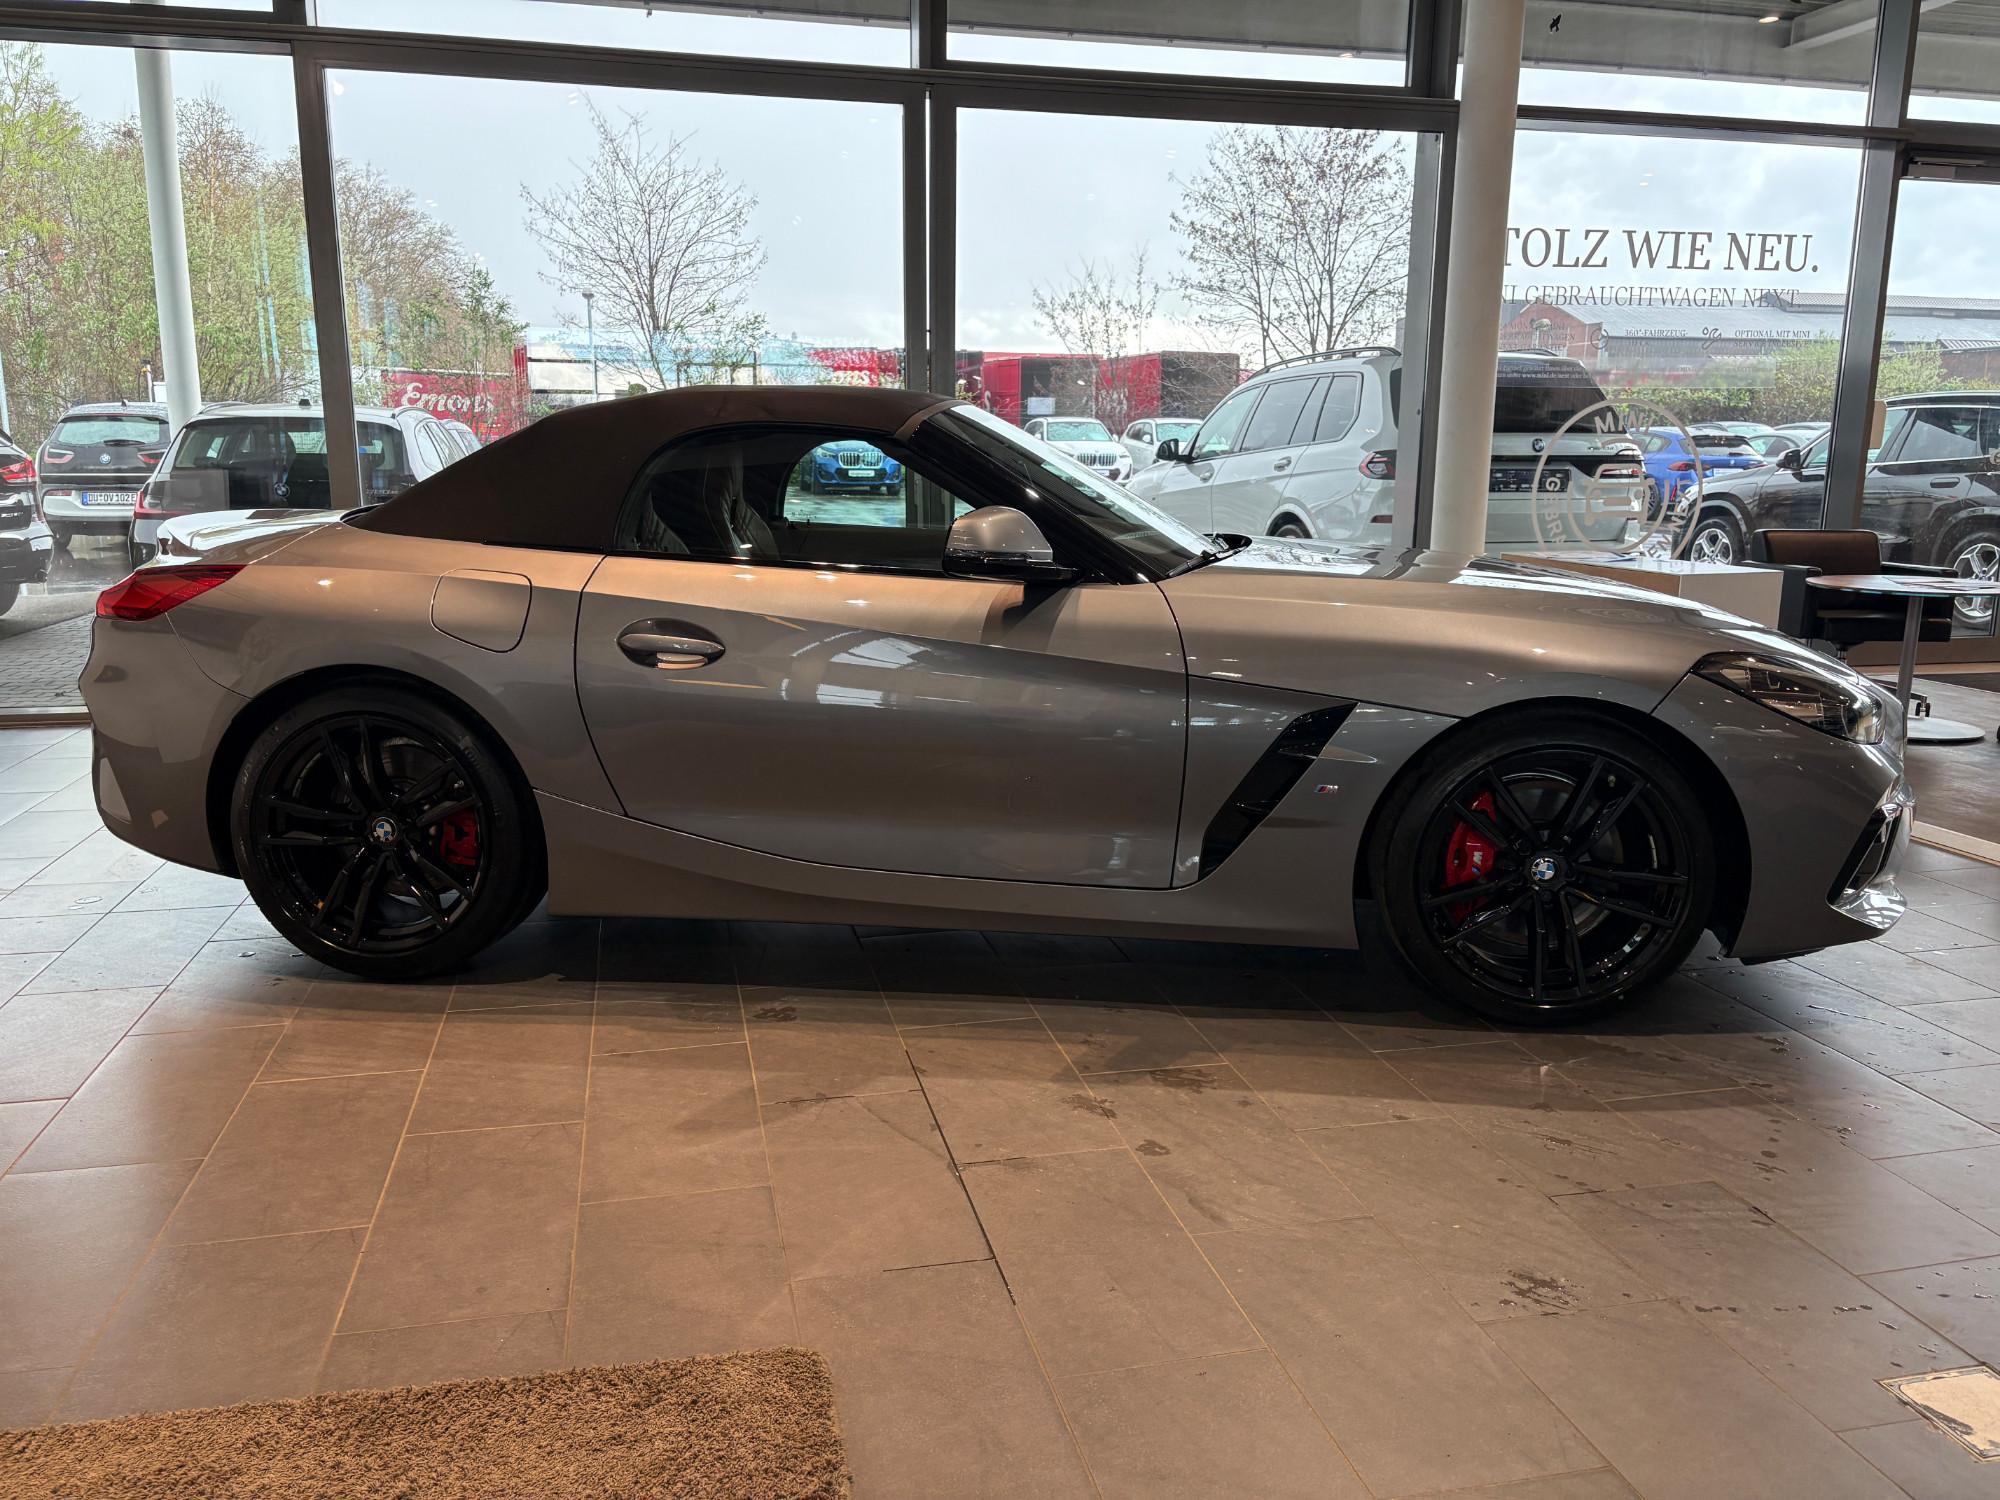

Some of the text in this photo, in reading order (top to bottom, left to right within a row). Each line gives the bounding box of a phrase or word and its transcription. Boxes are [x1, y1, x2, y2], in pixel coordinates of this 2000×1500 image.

[1622, 230, 1712, 270] WIE
[1723, 232, 1818, 273] NEU.
[1525, 285, 1736, 308] GEBRAUCHTWAGEN
[1735, 329, 1810, 339] OPTIONAL MIT MINI
